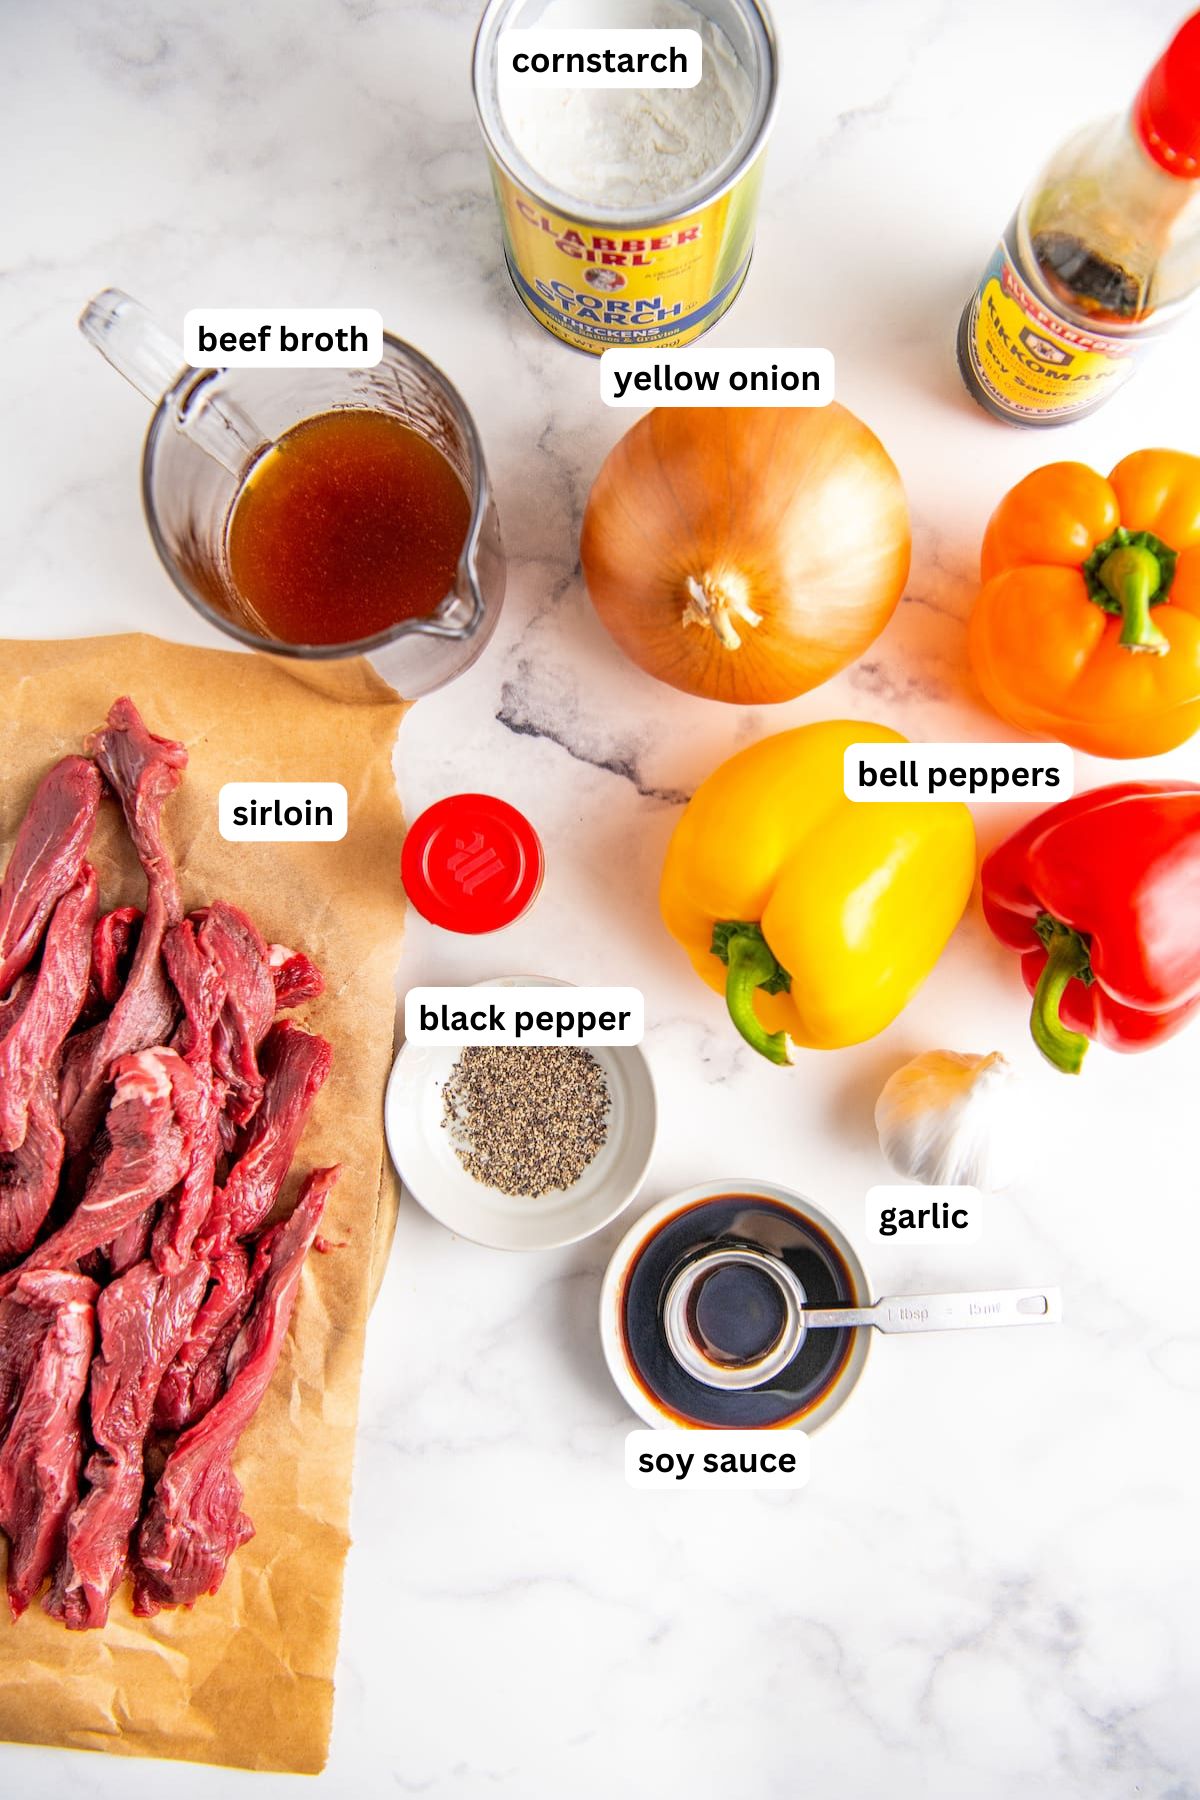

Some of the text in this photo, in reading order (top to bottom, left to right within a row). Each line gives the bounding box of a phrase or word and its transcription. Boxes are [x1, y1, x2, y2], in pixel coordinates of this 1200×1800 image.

[515, 200, 700, 252] CLABBER
[555, 239, 652, 267] GIRL
[535, 279, 682, 325] STARCH
[550, 280, 662, 314] CORN
[558, 313, 661, 338] THICKENS
[987, 293, 1117, 382] KIKKOMAN
[986, 339, 1009, 373] Soy
